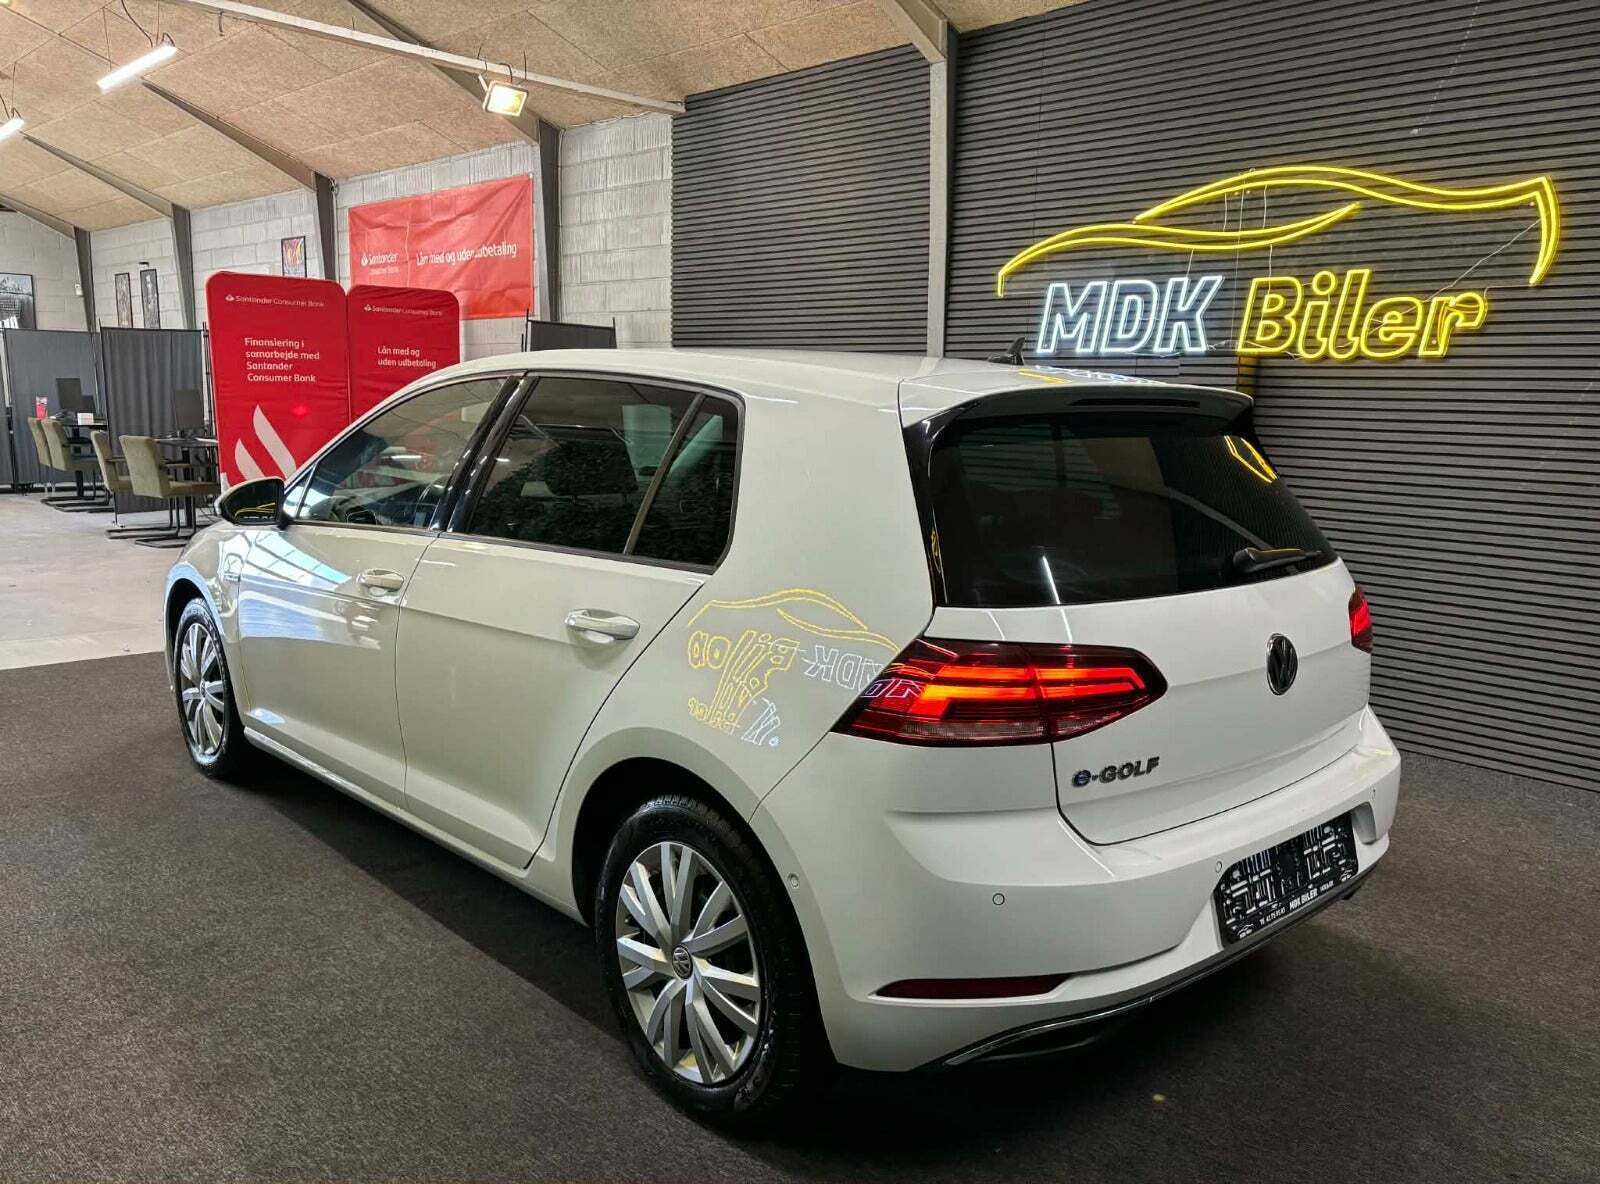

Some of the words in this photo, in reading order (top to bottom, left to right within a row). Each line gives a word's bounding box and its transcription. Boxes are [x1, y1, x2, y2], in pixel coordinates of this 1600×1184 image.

[429, 251, 444, 264] med
[446, 251, 455, 266] og
[235, 295, 272, 304] Santander
[273, 297, 307, 307] Consumer
[372, 305, 400, 314] Santander
[1037, 275, 1224, 354] MDK
[1237, 268, 1488, 360] Biler
[244, 336, 300, 350] Finansiering
[245, 350, 299, 361] samarbejde
[300, 351, 320, 360] med
[377, 345, 391, 355] Lån
[392, 347, 409, 356] med
[410, 349, 420, 358] og
[246, 361, 293, 370] Santander
[377, 358, 397, 366] uden
[398, 359, 437, 370] udbetaling
[247, 372, 293, 382] Consumer
[294, 373, 316, 382] Bank
[1071, 756, 1160, 788] e-GOLF
[1289, 897, 1301, 911] MDK
[1301, 887, 1318, 905] BILER
